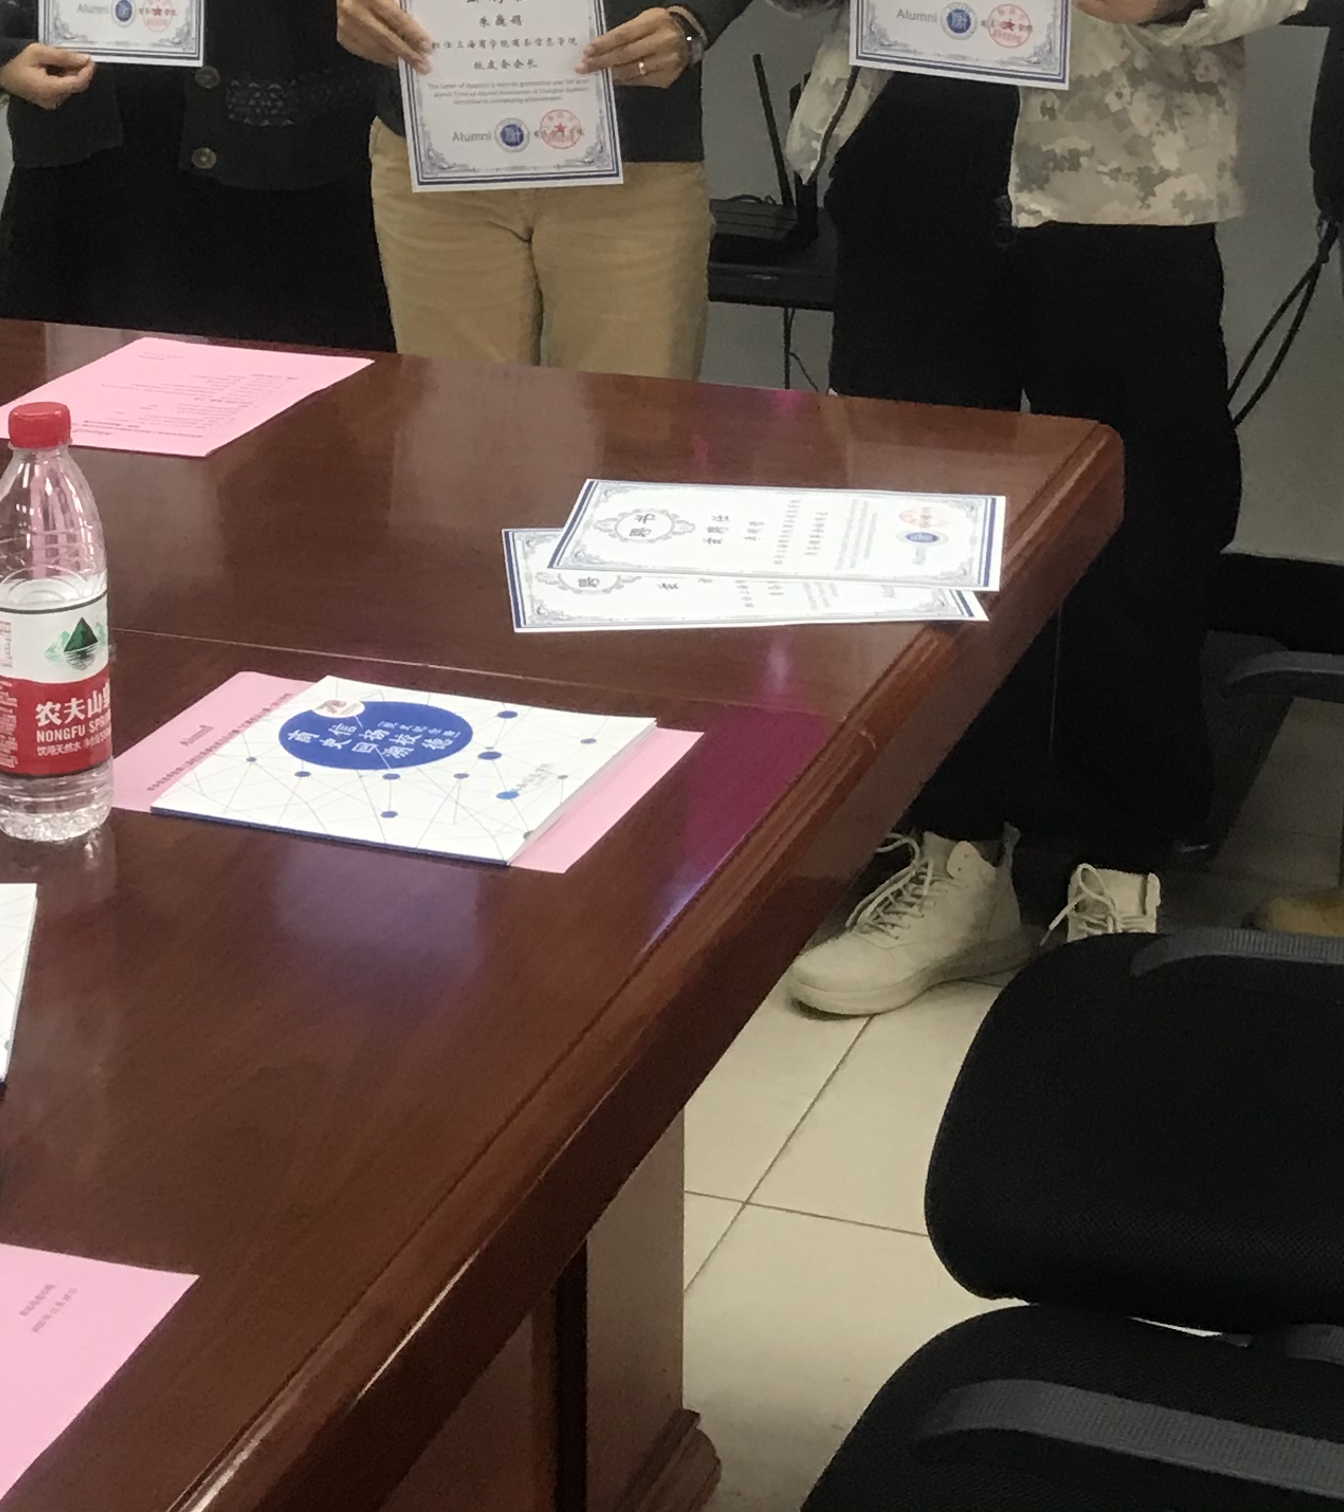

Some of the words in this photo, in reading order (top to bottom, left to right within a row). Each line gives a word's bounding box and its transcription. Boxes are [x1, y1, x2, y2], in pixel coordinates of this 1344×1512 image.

[896, 8, 937, 23] Alumni
[451, 131, 492, 143] Alumni
[36, 724, 86, 743] NONGFU
[287, 728, 416, 759] 商史回溯
